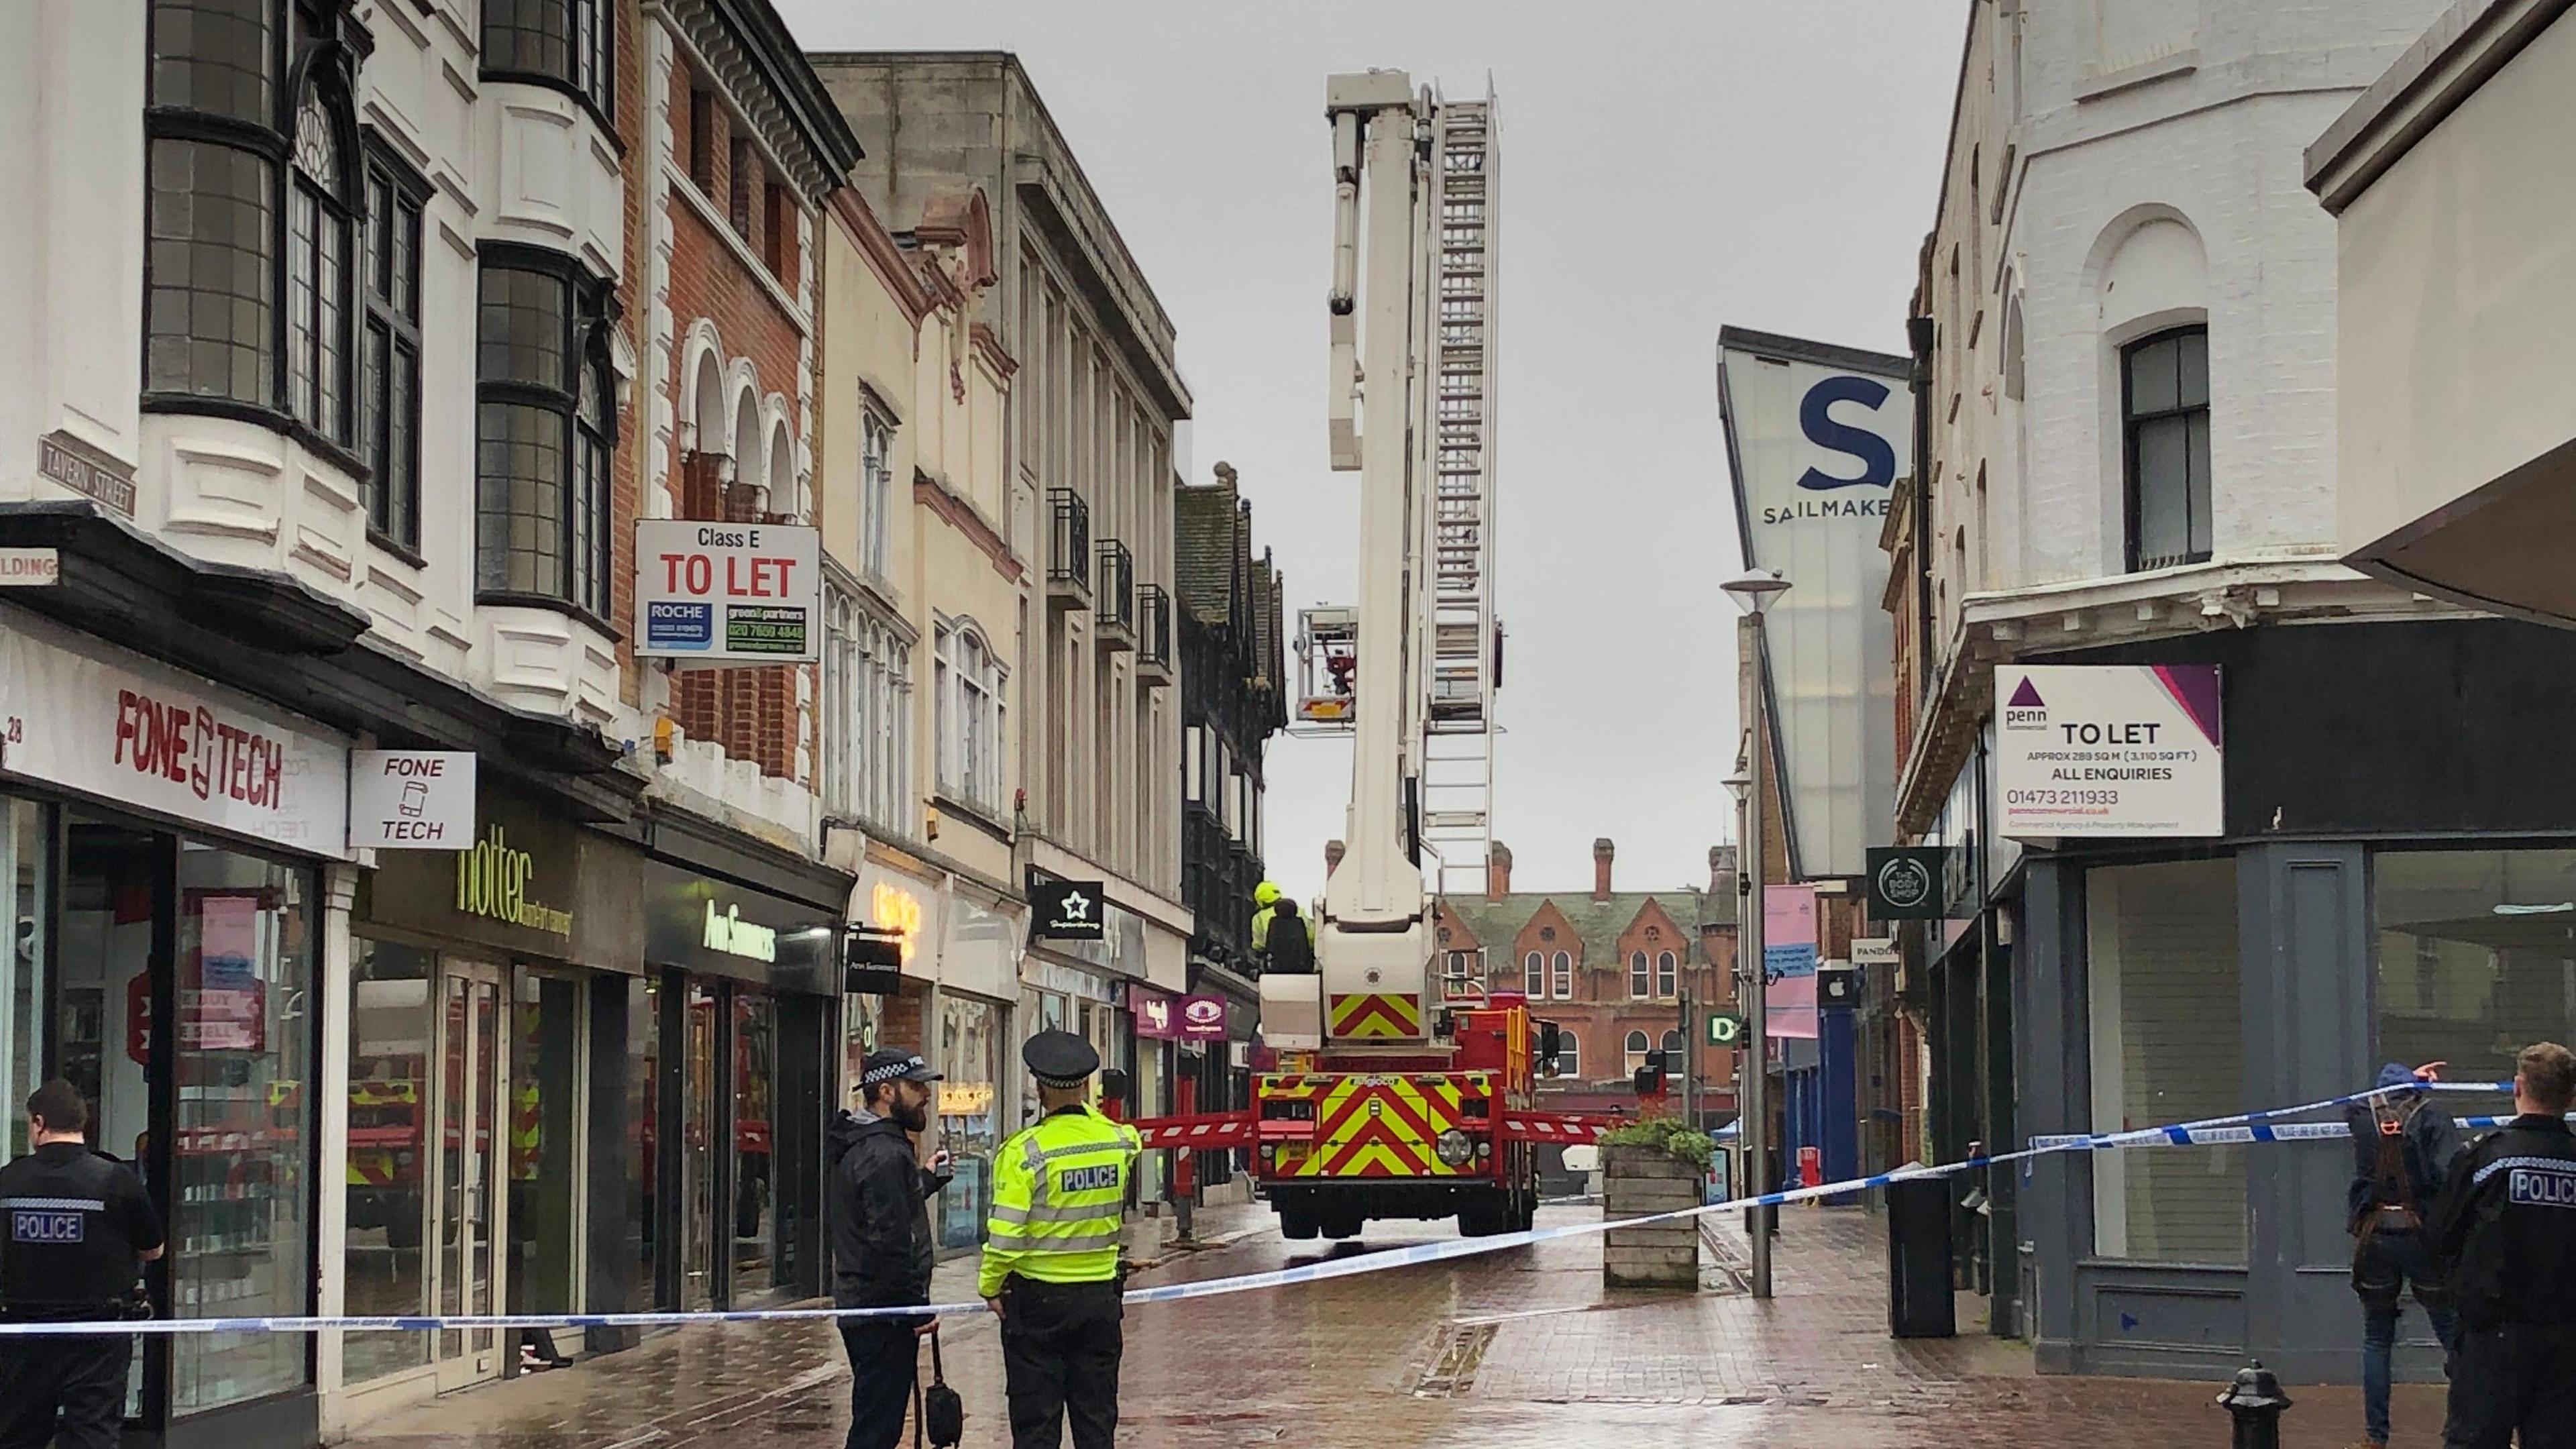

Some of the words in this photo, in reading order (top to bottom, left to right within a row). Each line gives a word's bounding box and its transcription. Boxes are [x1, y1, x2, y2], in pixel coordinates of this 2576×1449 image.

[1797, 376, 1895, 490] S
[47, 445, 89, 490] TAVERN
[94, 471, 131, 511] STREET
[698, 527, 744, 547] Class
[749, 531, 759, 548] E
[660, 554, 712, 595] TO
[727, 556, 796, 598] LET
[651, 605, 703, 619] ROCHE
[2006, 710, 2047, 725] penn
[2061, 723, 2100, 744] TO
[2108, 724, 2161, 744] LET
[115, 690, 190, 782] FONE
[217, 723, 282, 810] TECH
[2027, 752, 2070, 761] APPROX
[2094, 752, 2109, 761] SQ
[2112, 752, 2120, 760] M
[2159, 752, 2174, 761] SQ
[384, 759, 445, 777] FONE
[2051, 768, 2080, 780] ALL
[2085, 768, 2172, 780] ENQUIRIES
[2007, 790, 2057, 804] 01473
[2060, 790, 2118, 804] 211933
[382, 821, 443, 839] TECH
[1889, 879, 1919, 889] BODY
[1890, 889, 1919, 898] SHOP
[1064, 1165, 1116, 1191] POLICE
[2517, 1174, 2576, 1203] POLIC
[17, 1216, 77, 1239] POLICE
